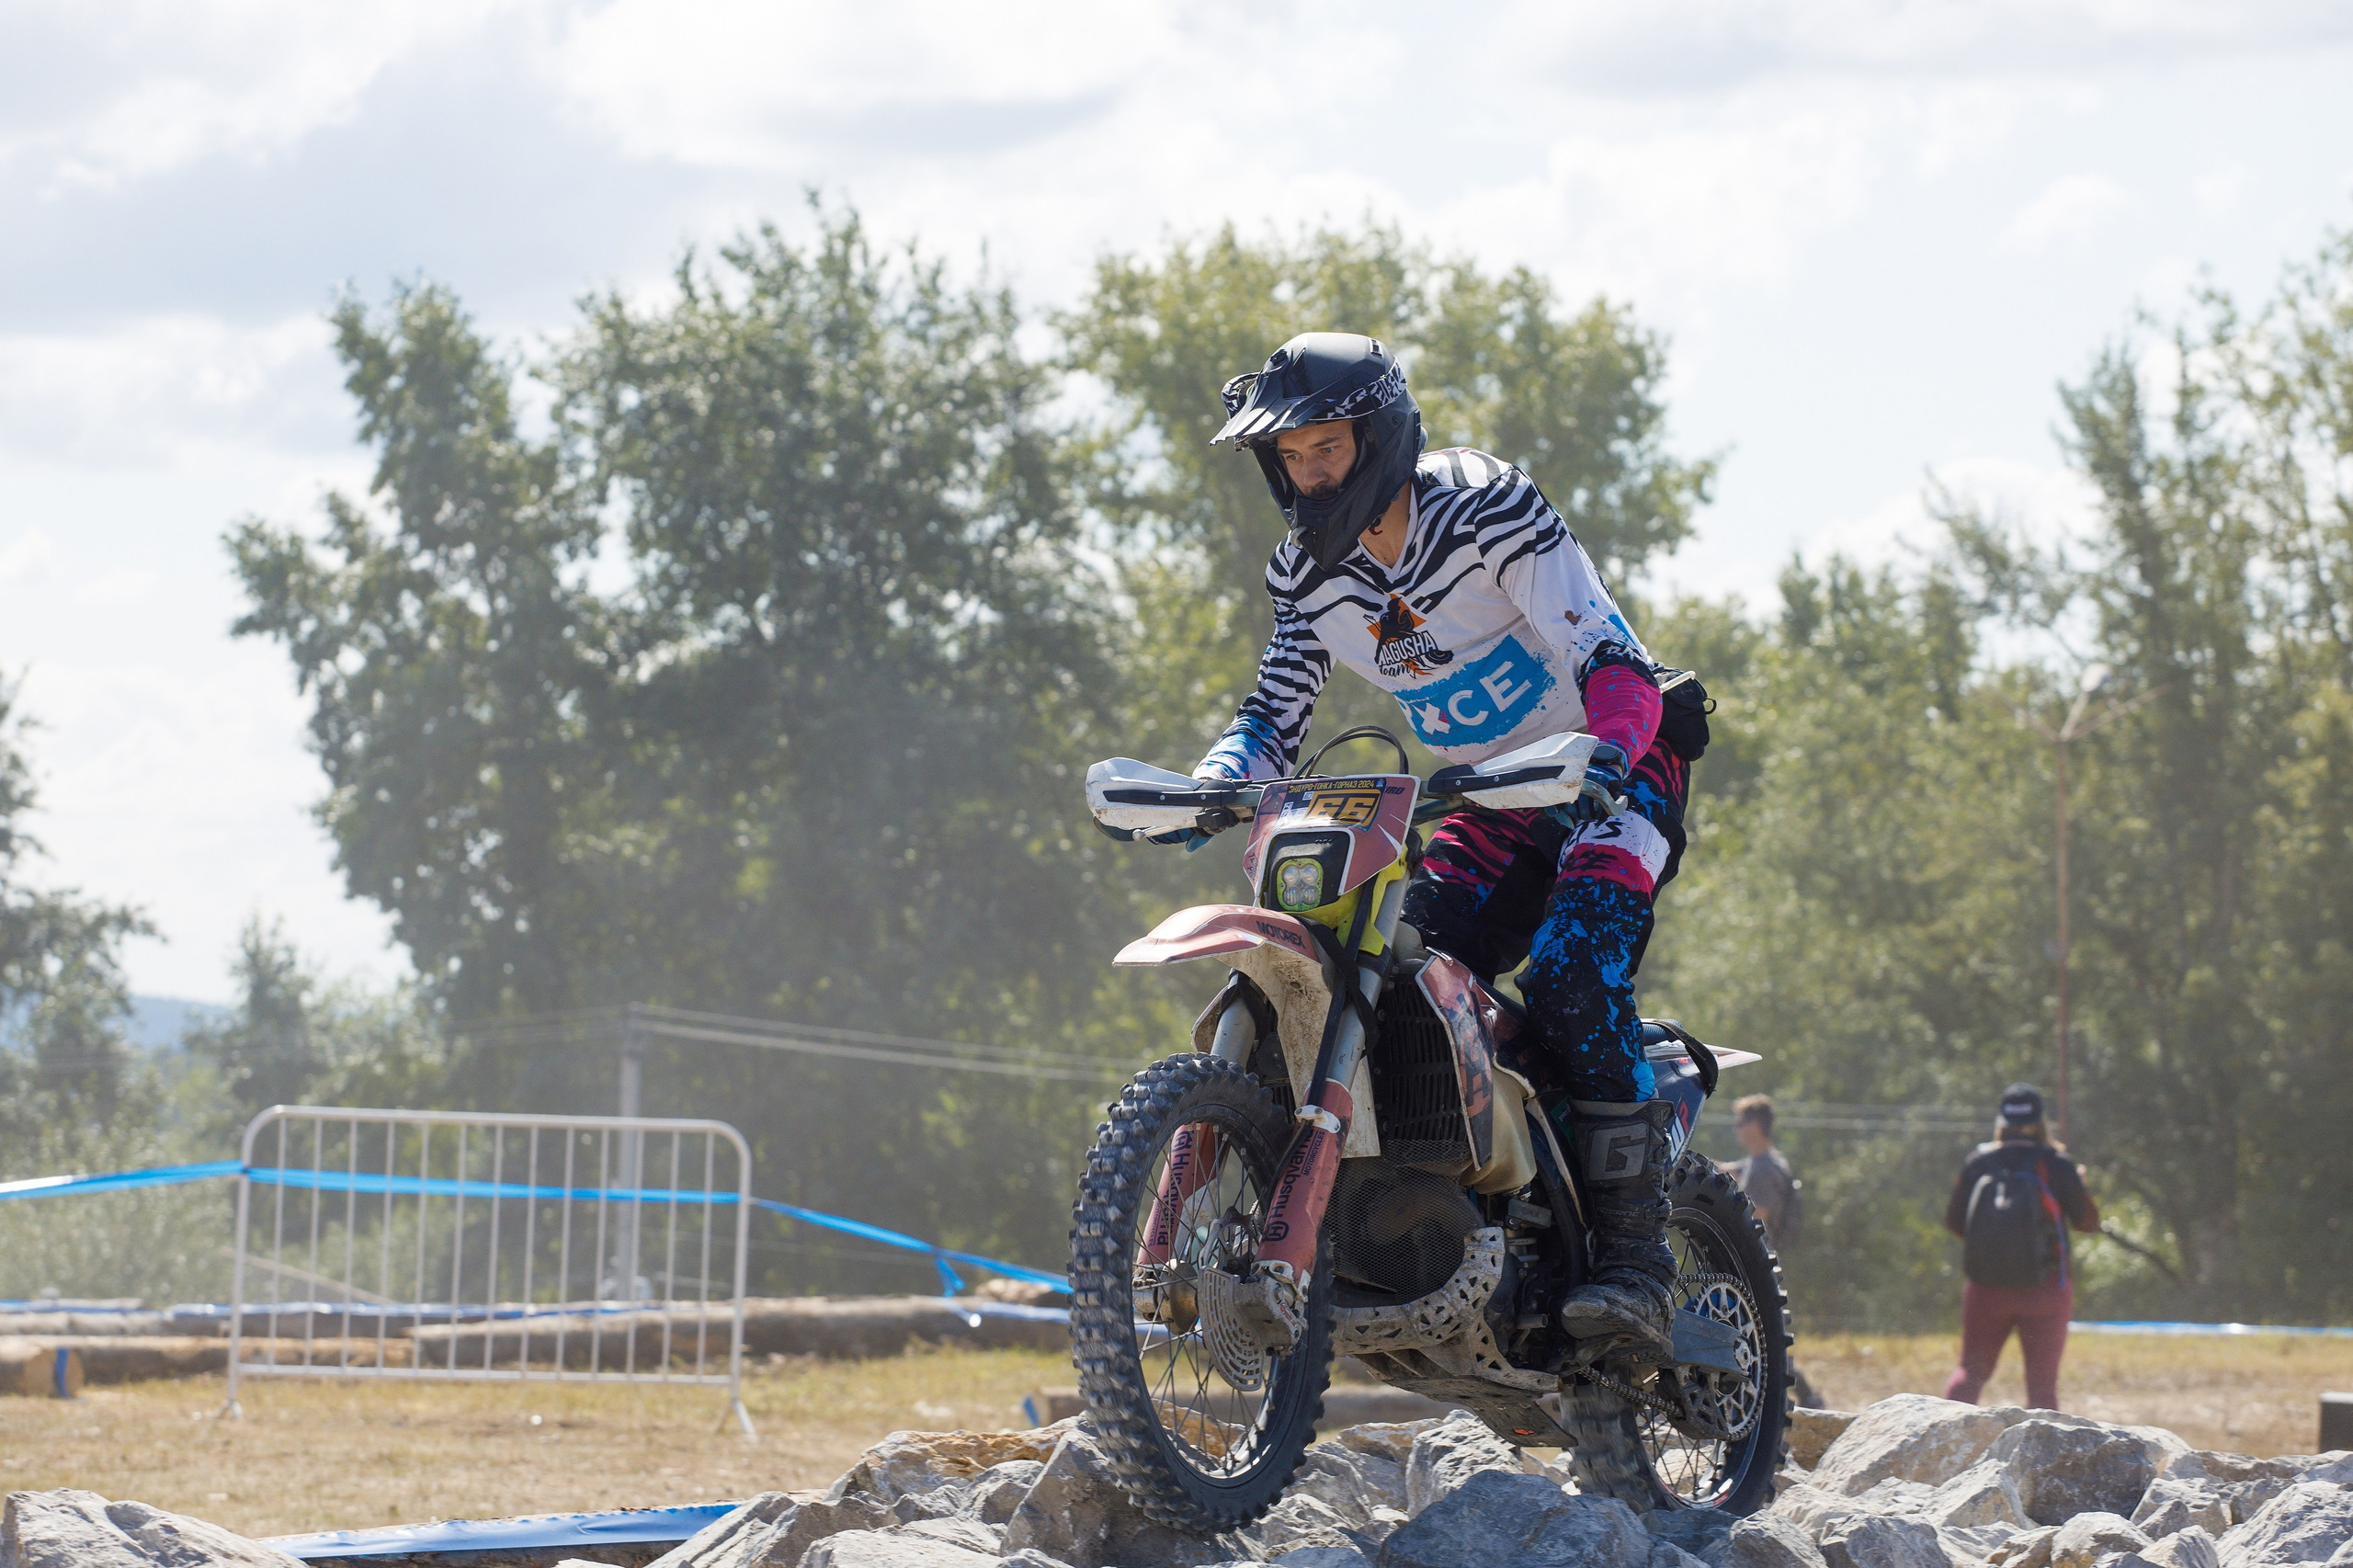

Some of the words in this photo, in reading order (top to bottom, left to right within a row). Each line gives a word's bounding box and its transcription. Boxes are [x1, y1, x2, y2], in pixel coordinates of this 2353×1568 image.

[1358, 779, 1374, 789] 2024
[1310, 796, 1377, 822] 66
[1256, 920, 1306, 949] MOTOREX
[1303, 1131, 1325, 1176] MOTORCYCLES
